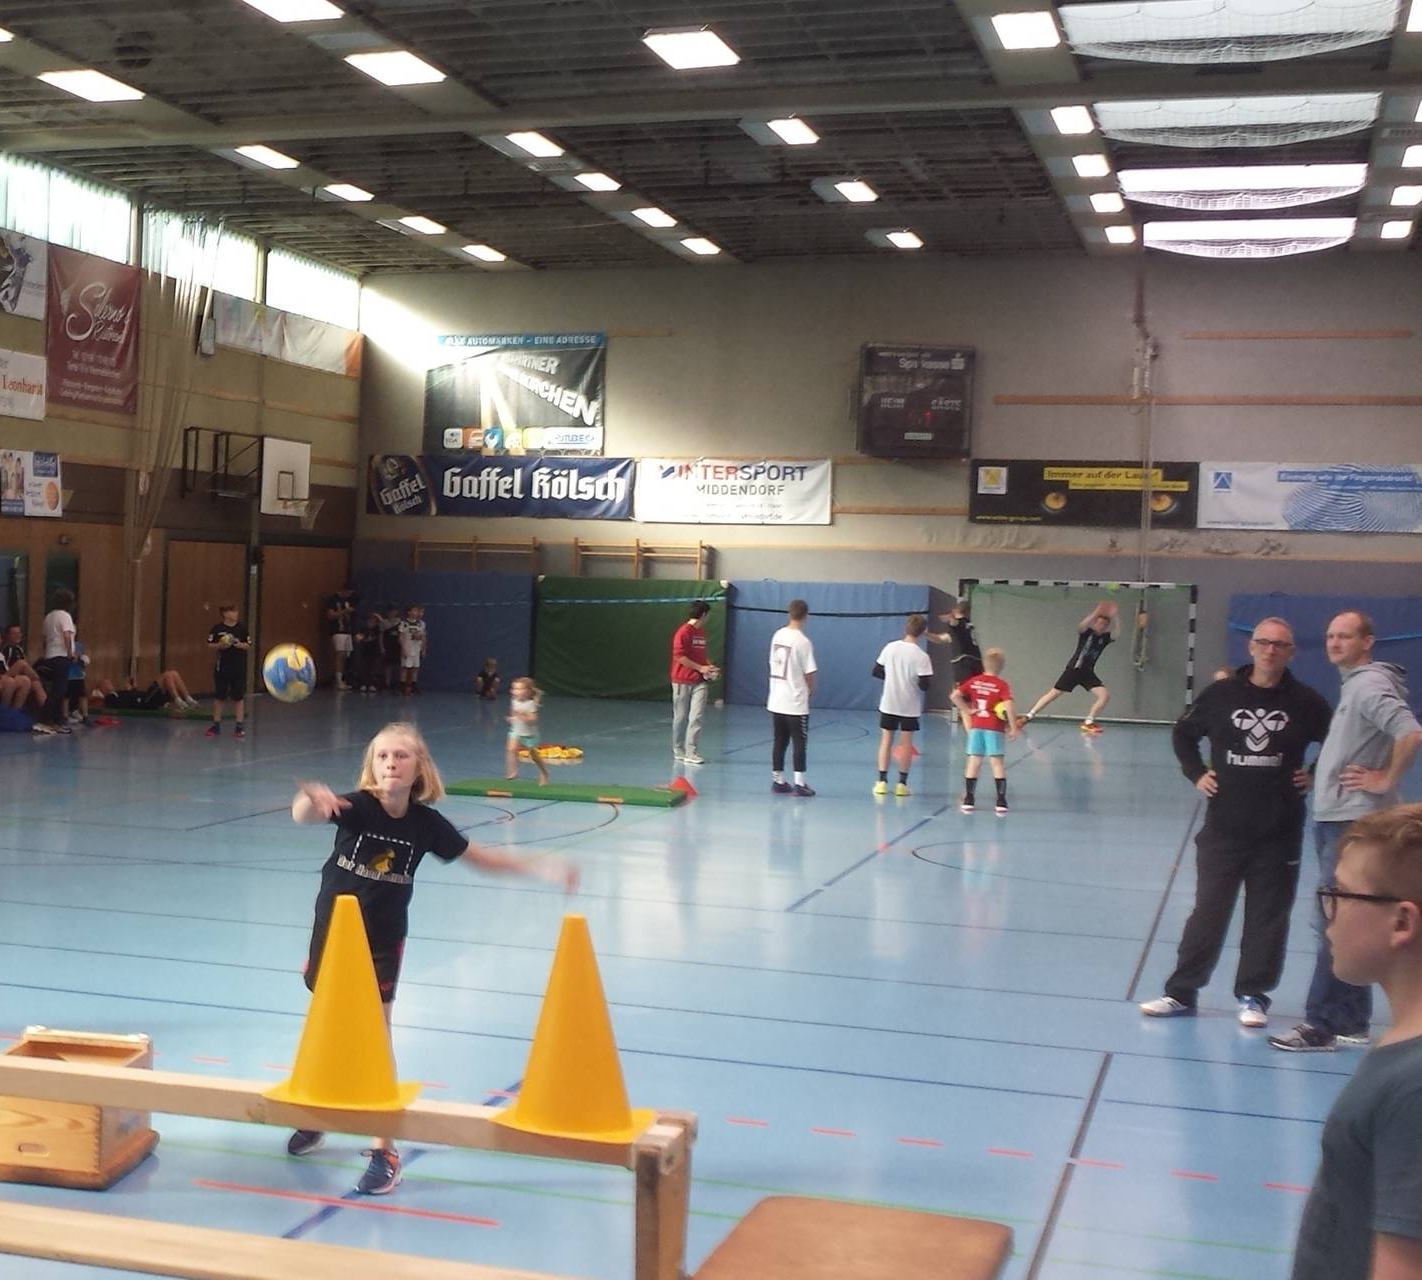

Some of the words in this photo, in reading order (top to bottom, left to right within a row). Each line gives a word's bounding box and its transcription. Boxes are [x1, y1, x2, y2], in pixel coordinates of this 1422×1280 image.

[467, 336, 524, 346] AUTOMARKEN
[534, 336, 555, 345] EINE
[556, 335, 596, 345] ADRESSE
[380, 473, 427, 506] Gaffel
[442, 467, 525, 501] Gaffel
[531, 467, 627, 503] Kölsch
[696, 484, 786, 496] MIDDENDORF
